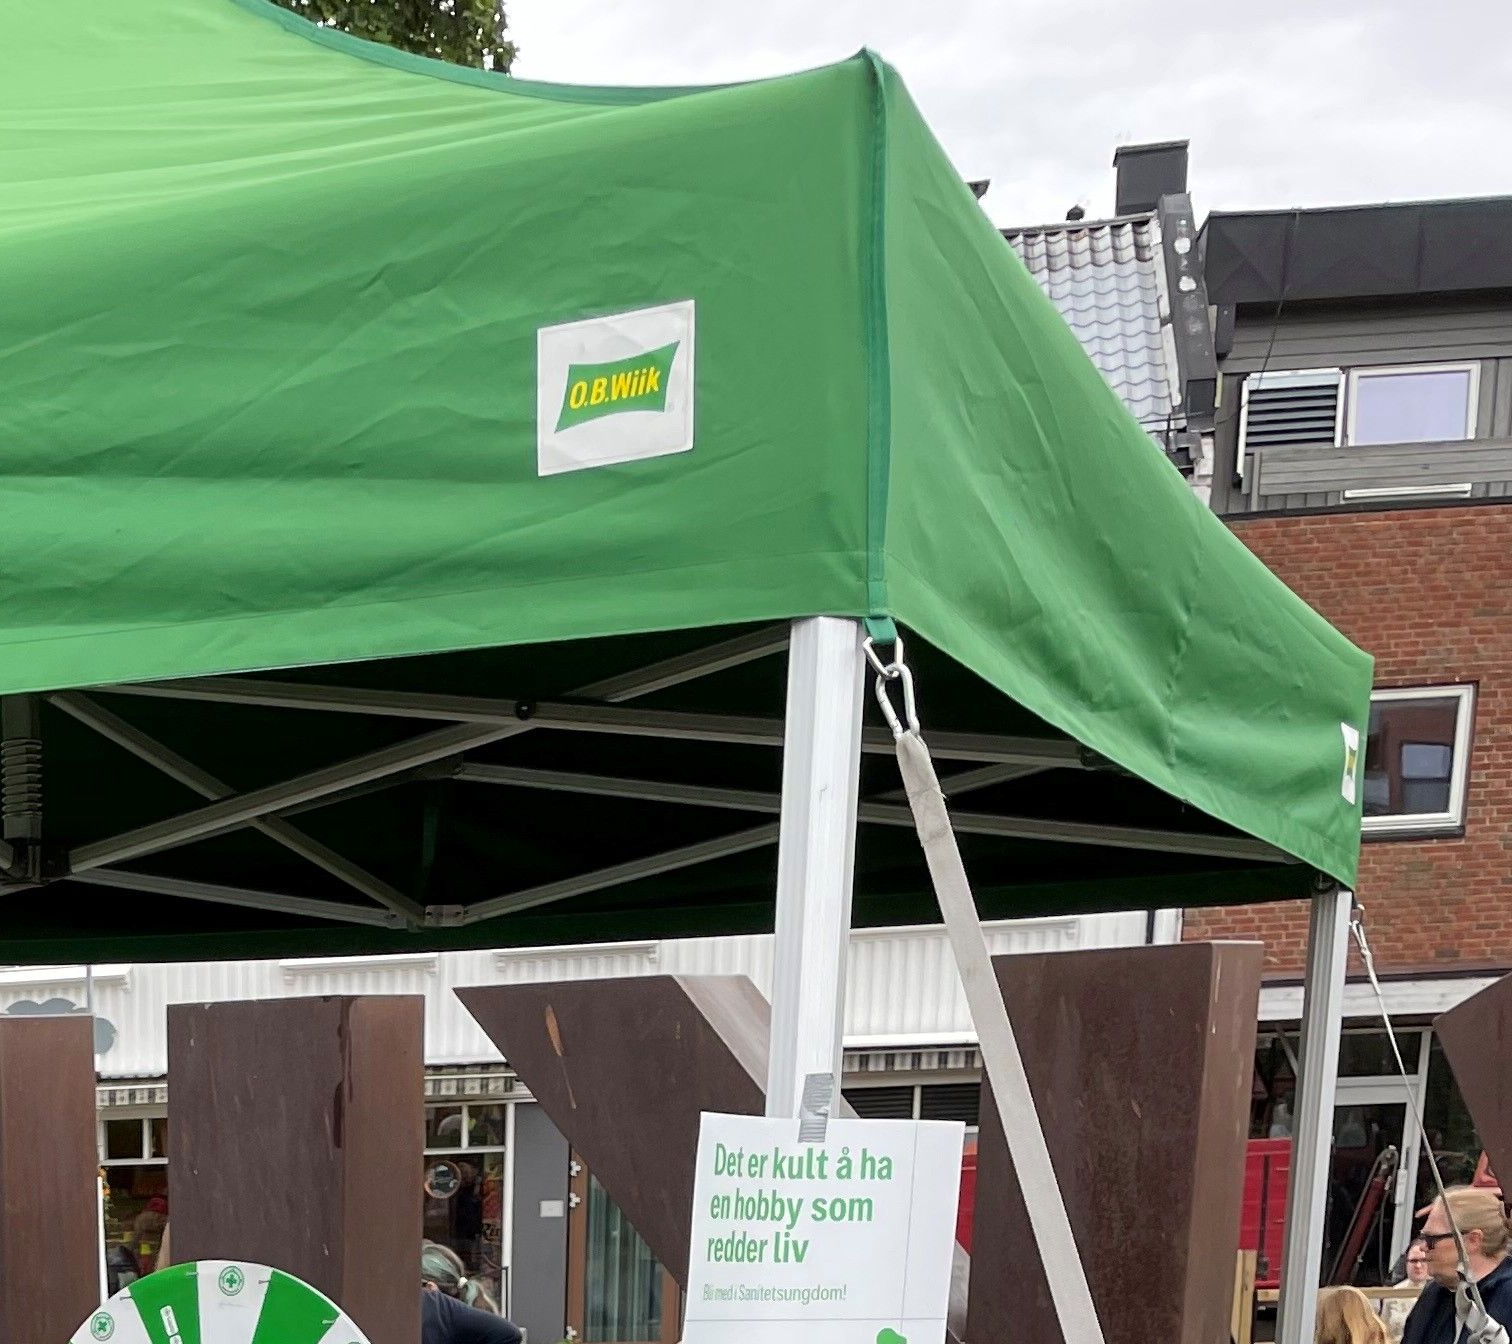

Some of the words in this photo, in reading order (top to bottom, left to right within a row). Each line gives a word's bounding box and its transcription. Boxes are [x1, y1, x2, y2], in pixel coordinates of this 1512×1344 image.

[714, 1143, 745, 1177] Det
[747, 1152, 769, 1179] er
[772, 1147, 829, 1180] kult
[836, 1146, 852, 1180] å
[860, 1148, 893, 1180] ha
[710, 1193, 731, 1220] en
[733, 1188, 804, 1230] hobby
[811, 1196, 874, 1222] som
[707, 1230, 769, 1263] redder
[773, 1231, 810, 1263] liv
